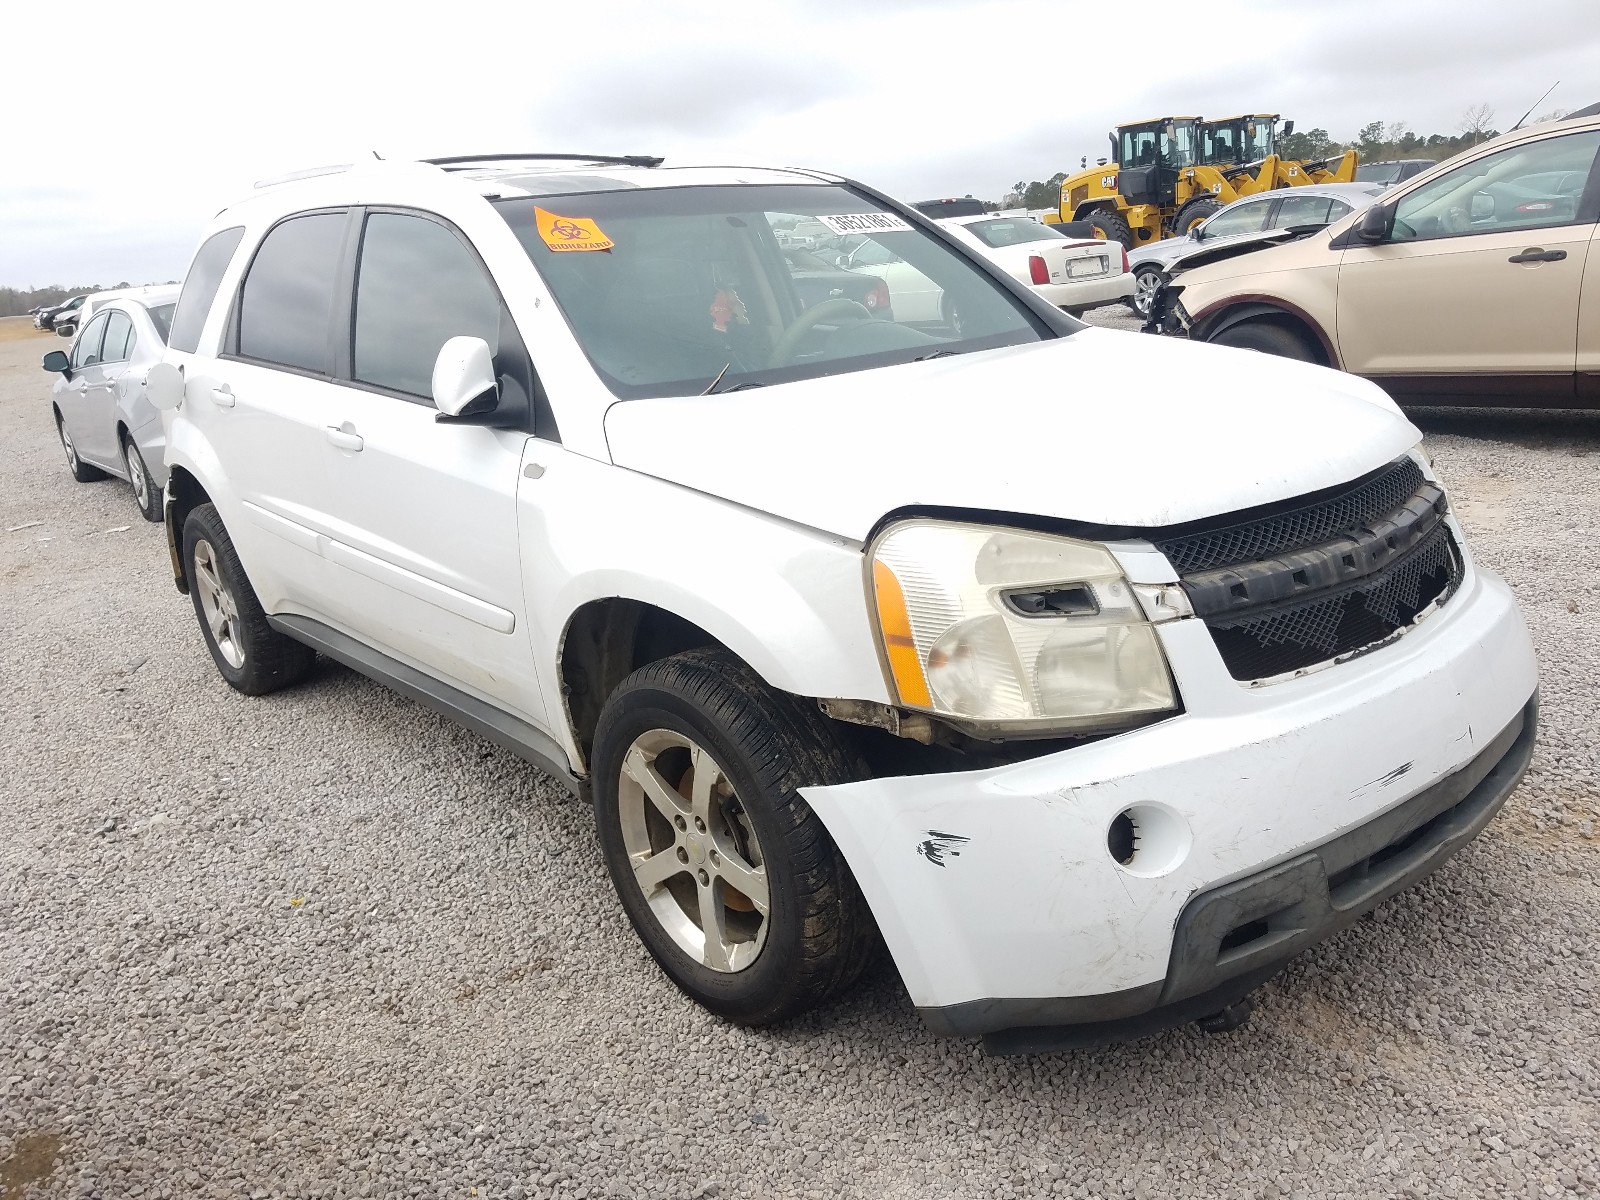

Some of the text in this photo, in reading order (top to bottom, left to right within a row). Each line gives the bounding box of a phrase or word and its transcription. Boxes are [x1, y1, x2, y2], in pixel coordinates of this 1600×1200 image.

[1101, 175, 1116, 188] CAT
[828, 215, 897, 230] 36521861
[549, 241, 611, 250] BIOHAZARD
